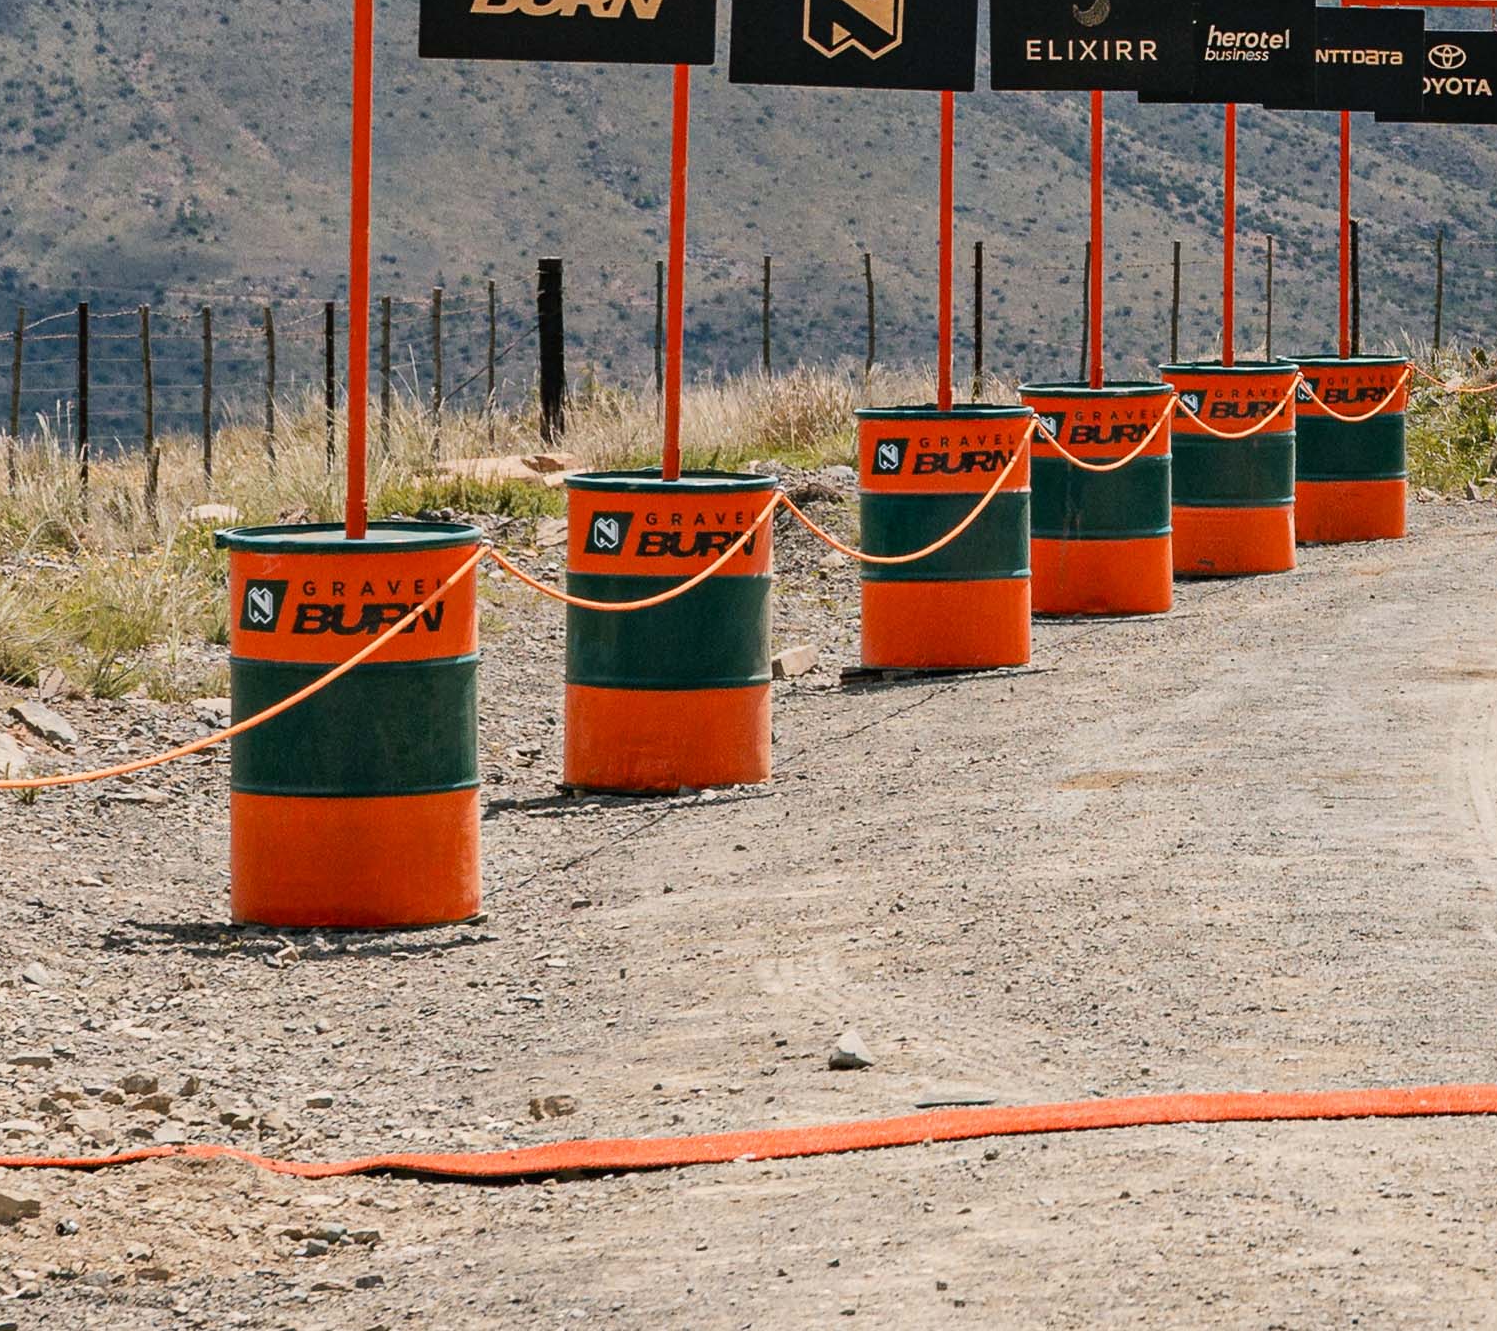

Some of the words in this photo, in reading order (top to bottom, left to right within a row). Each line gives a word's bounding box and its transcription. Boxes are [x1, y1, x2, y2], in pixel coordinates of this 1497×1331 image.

[1207, 25, 1290, 49] herotel
[1026, 39, 1158, 62] ELIXIRR
[1205, 47, 1270, 61] business
[1423, 77, 1492, 96] YOTA
[919, 435, 1015, 448] GRAVEL
[913, 450, 1014, 476] BURN
